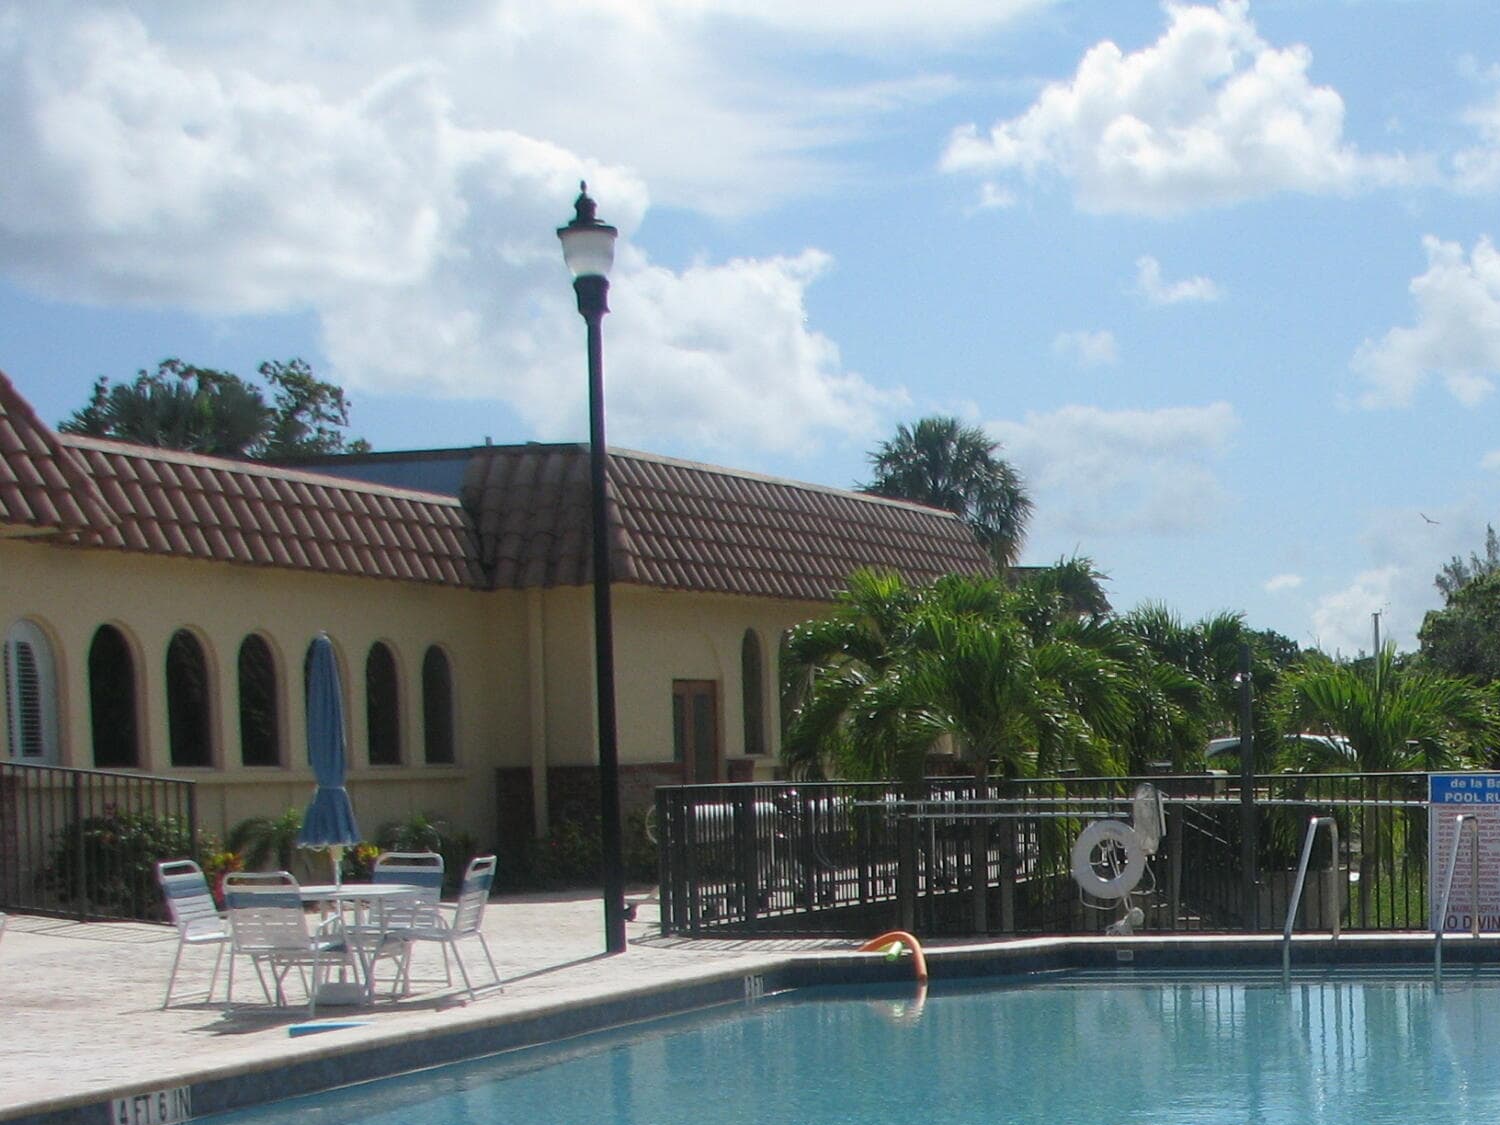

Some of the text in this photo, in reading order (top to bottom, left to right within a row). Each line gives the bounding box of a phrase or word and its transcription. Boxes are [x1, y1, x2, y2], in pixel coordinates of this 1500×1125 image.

[1450, 779, 1466, 788] de
[1470, 779, 1483, 788] la
[1445, 792, 1480, 803] POOL
[158, 1091, 168, 1122] 6
[174, 1087, 190, 1119] IN
